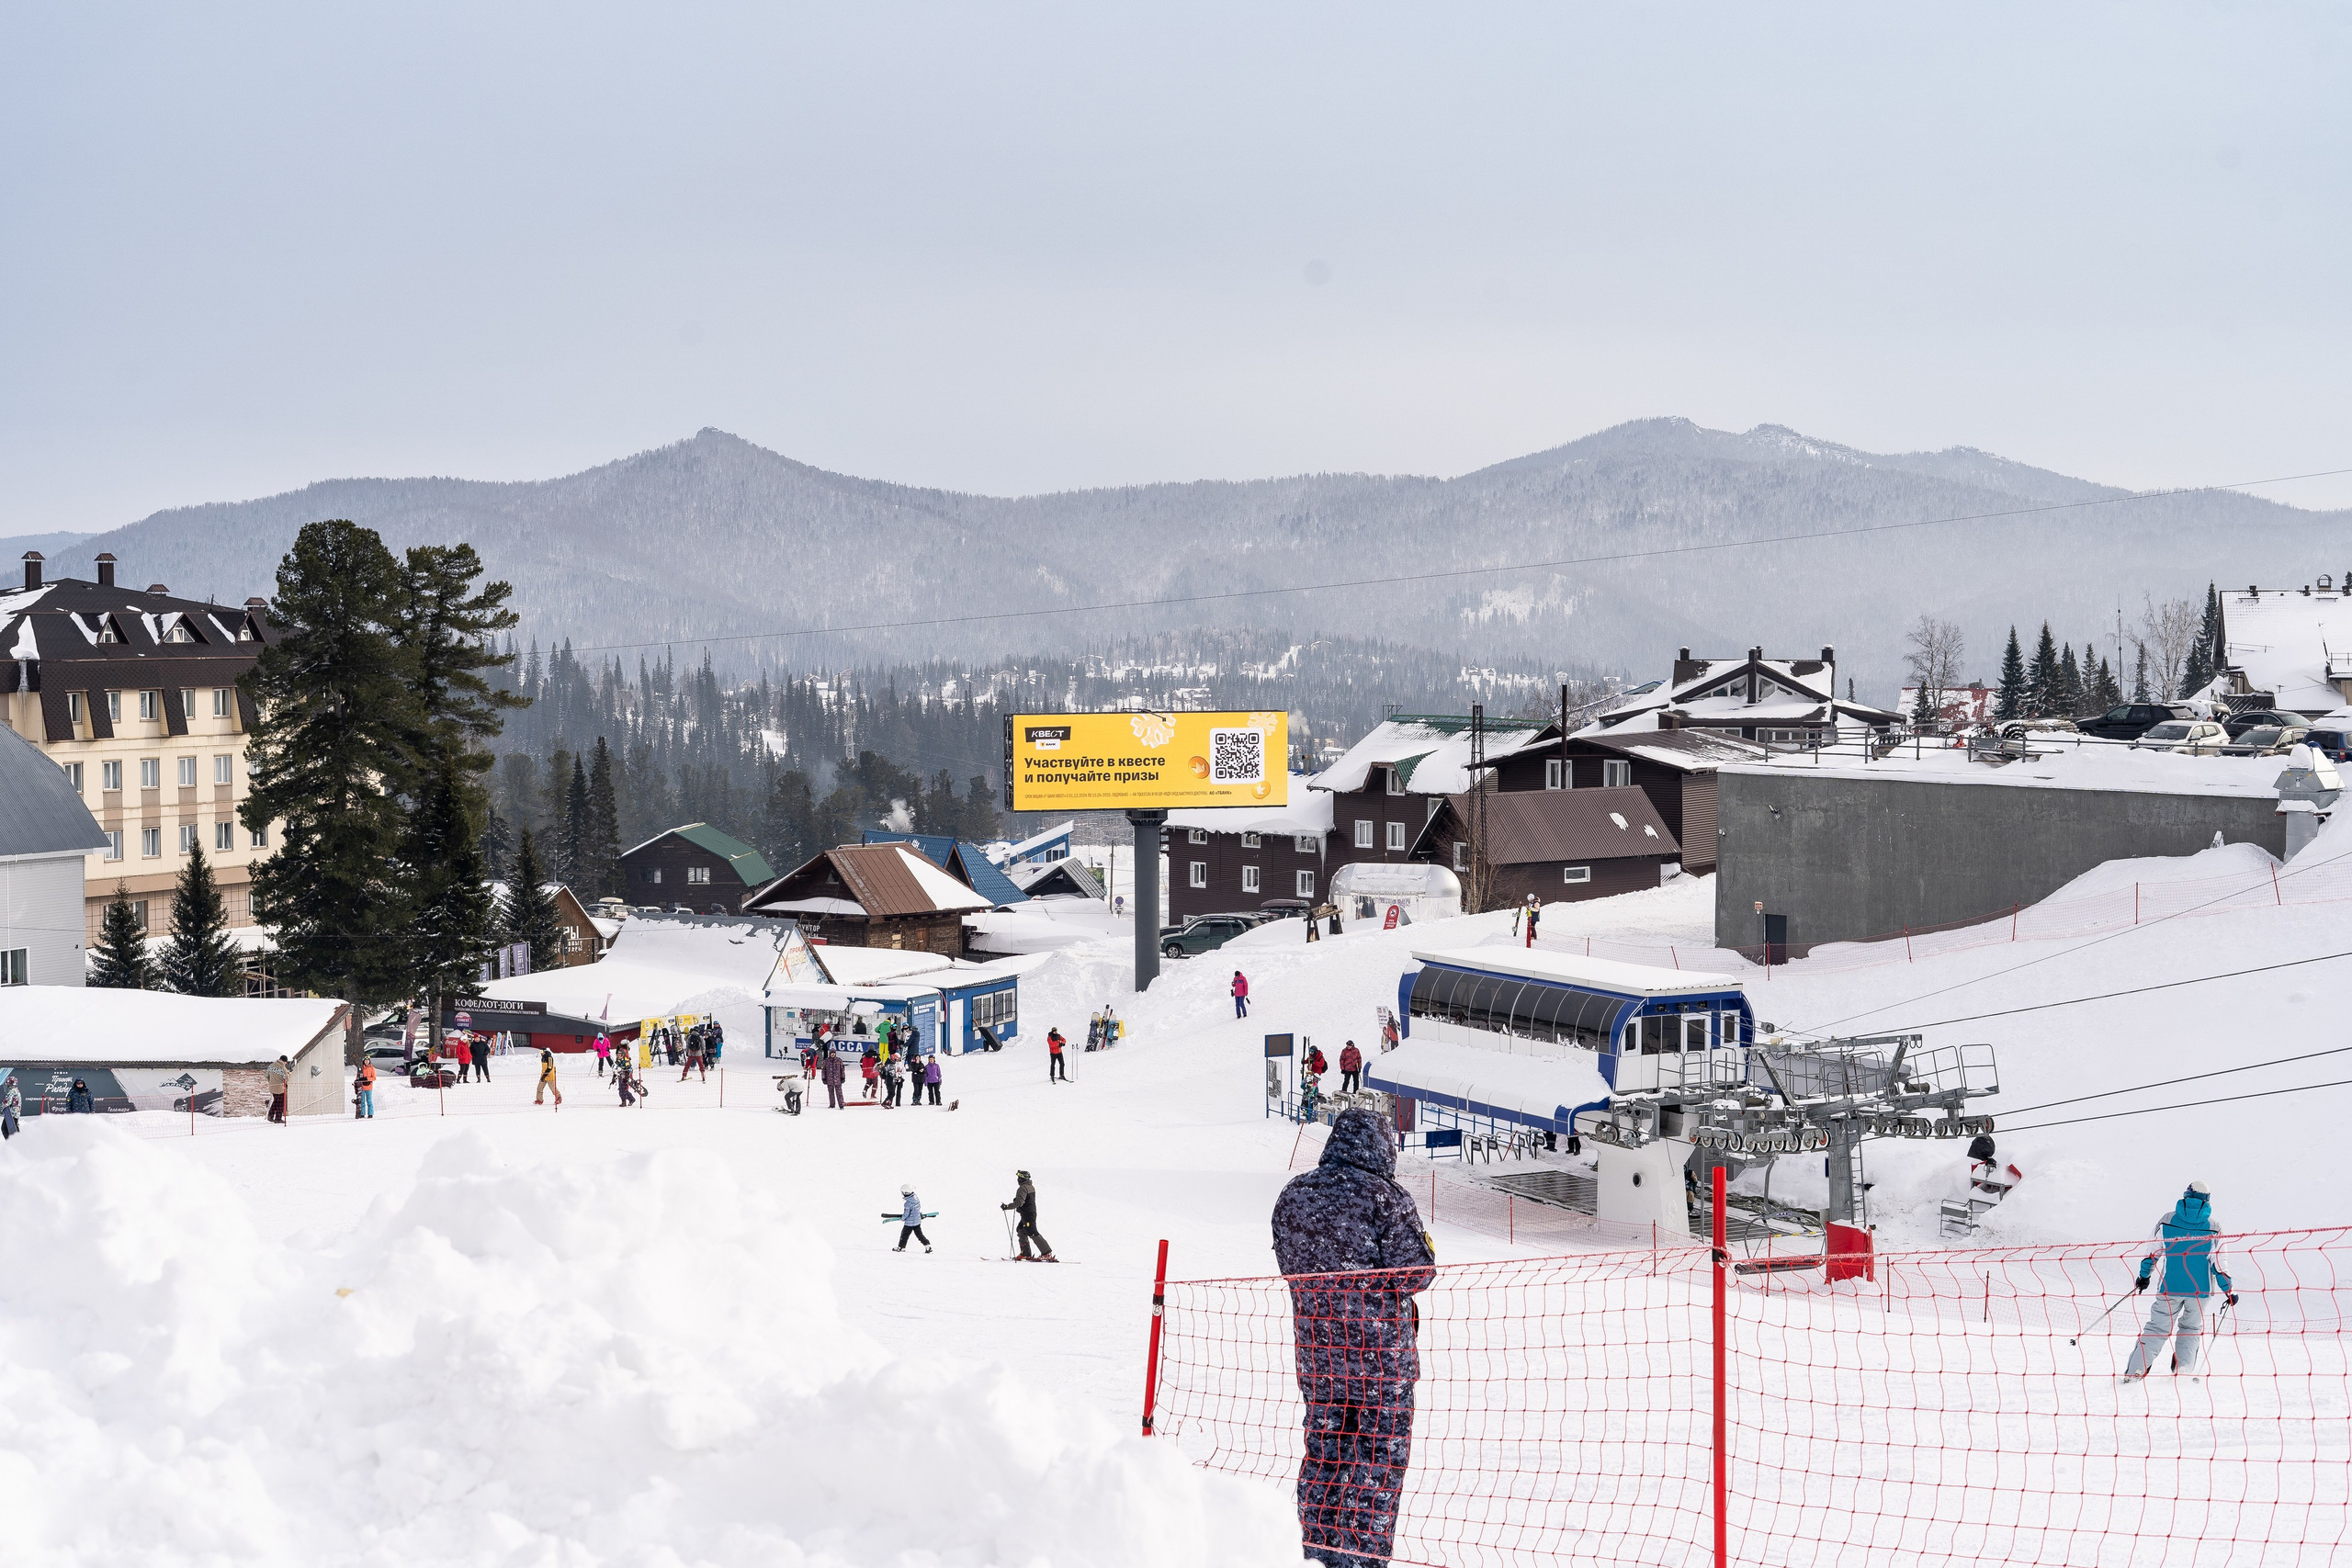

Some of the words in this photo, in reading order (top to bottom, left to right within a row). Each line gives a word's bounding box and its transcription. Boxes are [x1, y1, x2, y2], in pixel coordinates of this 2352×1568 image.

[1024, 756, 1104, 770] Участвуйте
[1107, 758, 1114, 767] в
[1118, 757, 1166, 767] квесте
[1024, 773, 1033, 783] и
[1036, 771, 1111, 784] получайте
[1114, 771, 1159, 784] призы
[454, 998, 525, 1010] КОФЕ/ХОТ-ДОГИ
[829, 1041, 864, 1052] АССА
